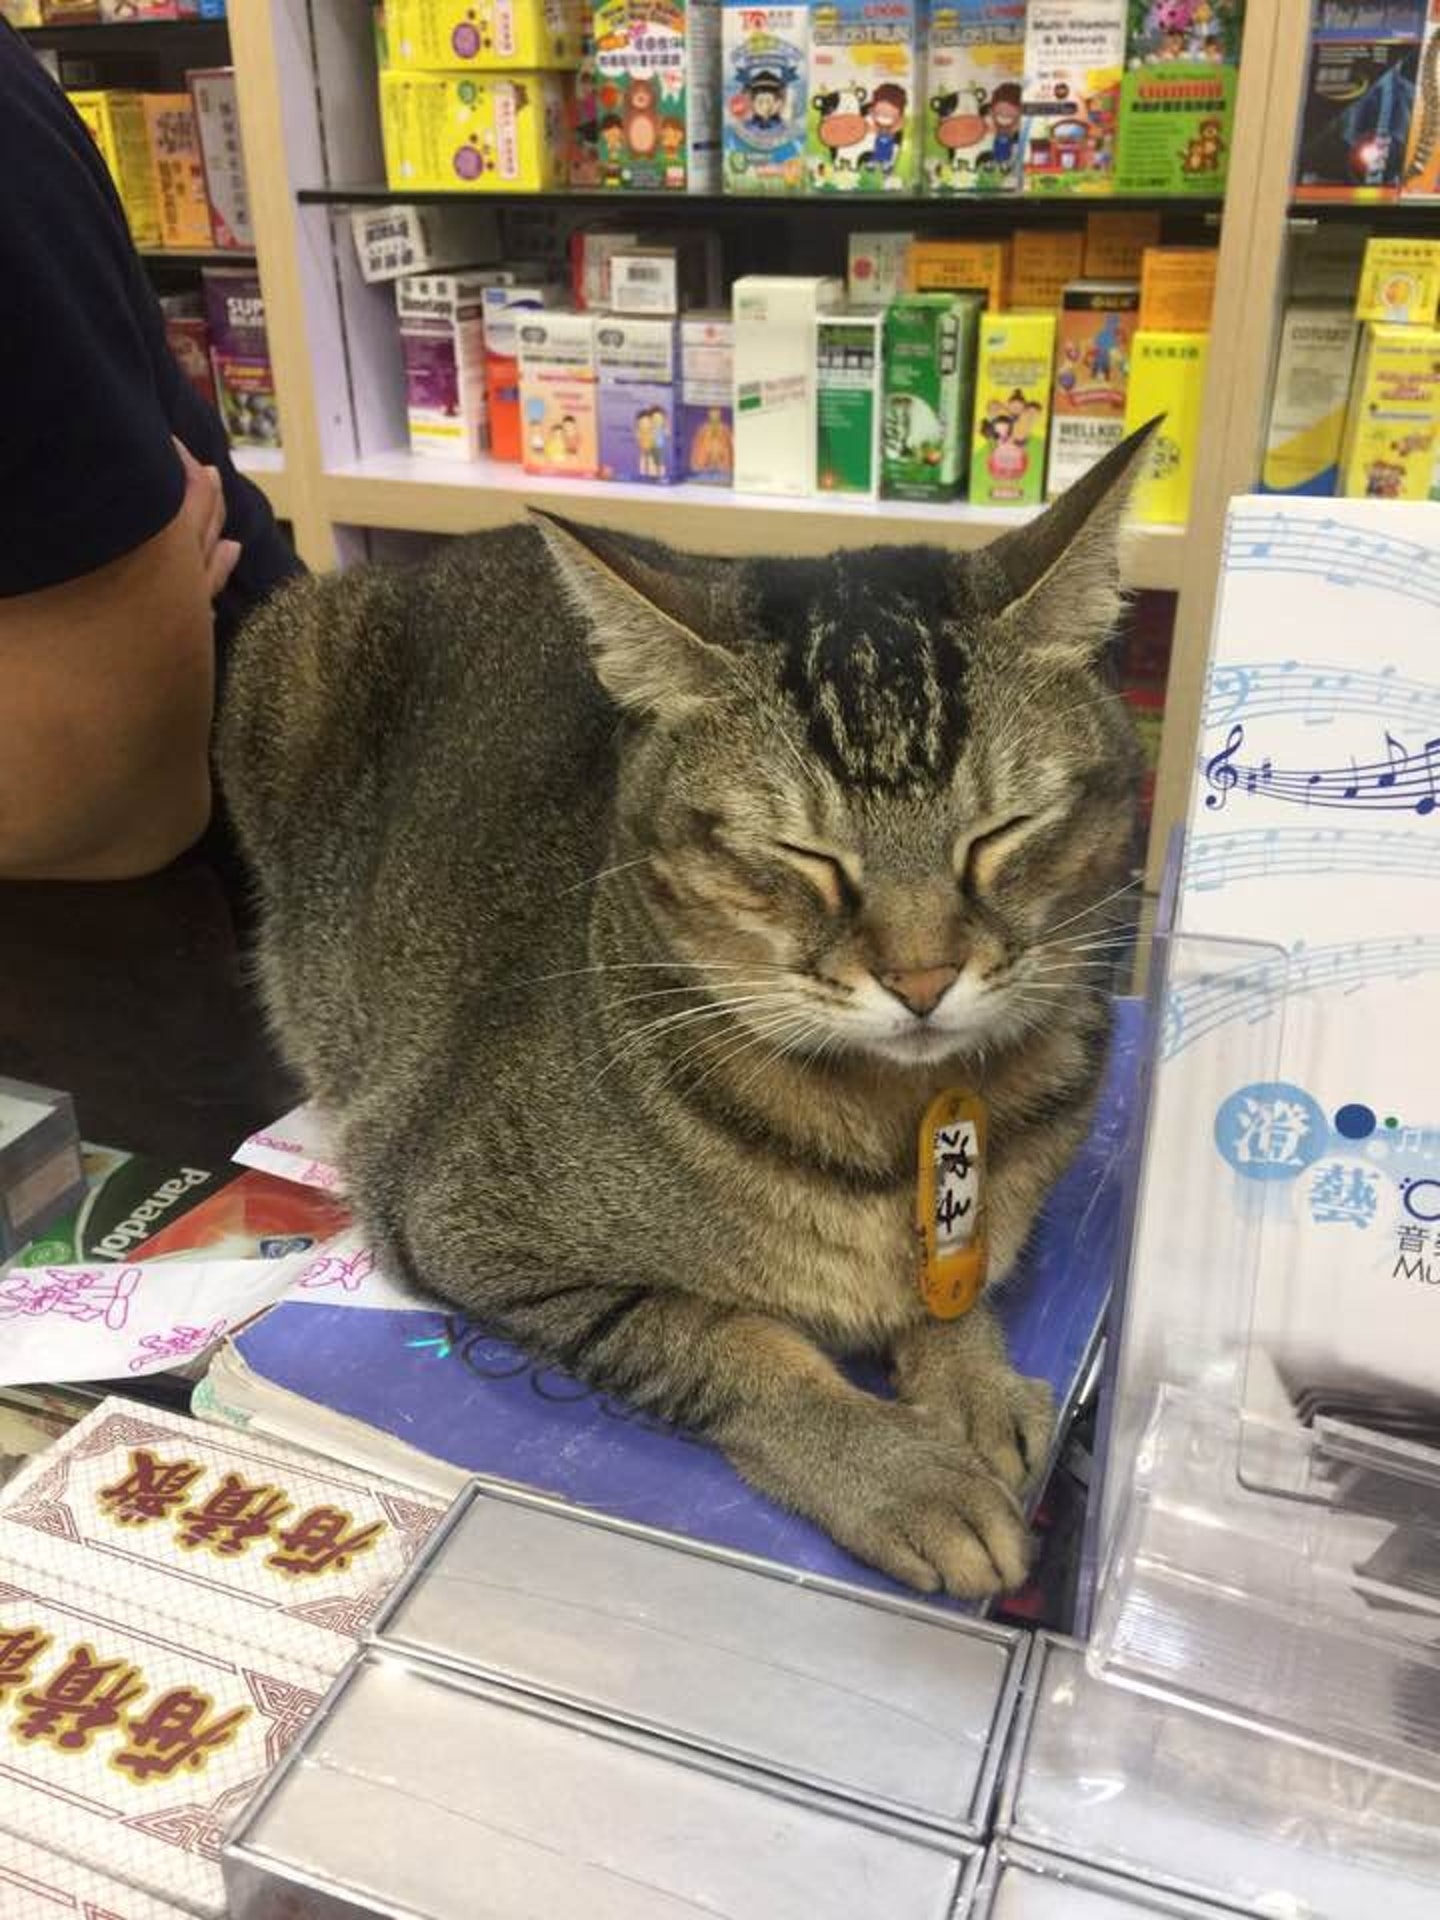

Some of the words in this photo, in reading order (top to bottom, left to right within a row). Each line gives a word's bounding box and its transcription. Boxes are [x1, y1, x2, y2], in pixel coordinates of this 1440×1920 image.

[91, 1167, 212, 1261] Panadol
[100, 1449, 388, 1576] 疳積散
